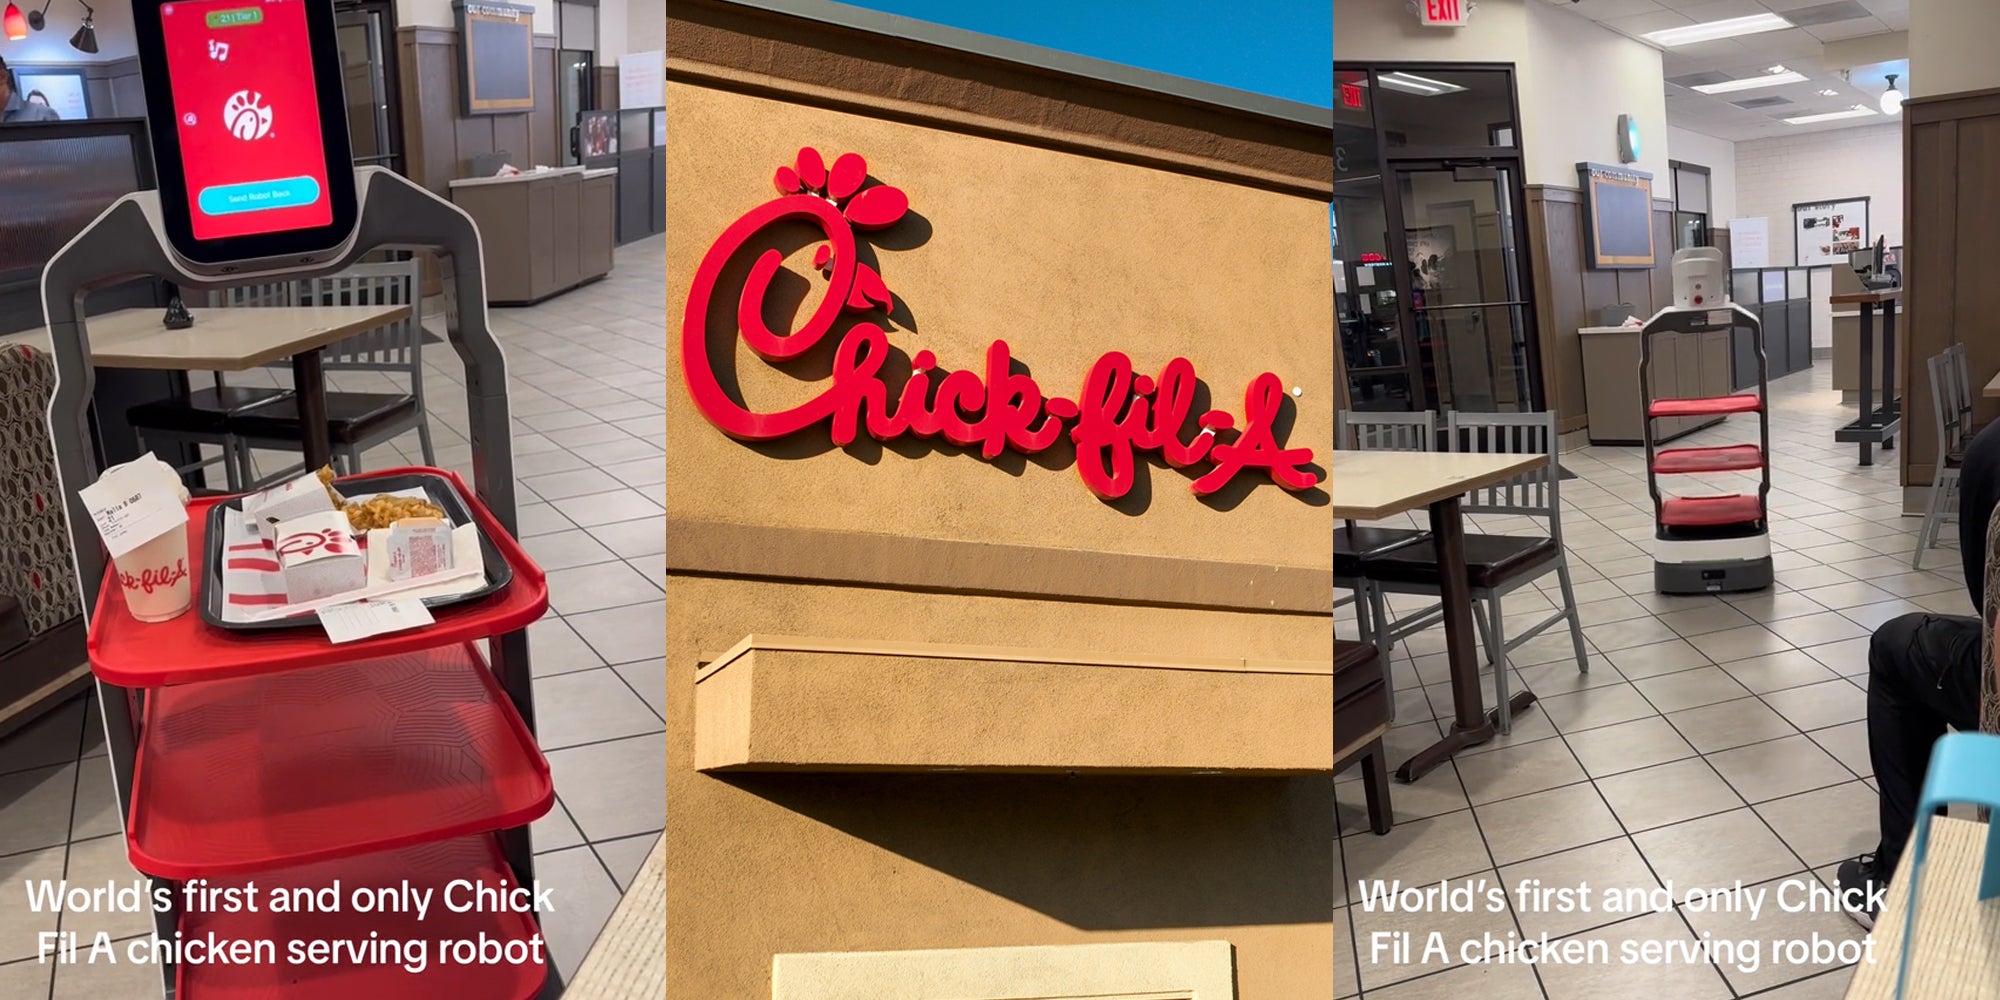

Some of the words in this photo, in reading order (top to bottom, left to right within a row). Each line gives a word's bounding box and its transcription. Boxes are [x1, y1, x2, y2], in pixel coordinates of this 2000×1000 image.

[482, 6, 520, 22] community
[1426, 0, 1460, 22] EXIT
[1604, 170, 1640, 186] community
[682, 148, 1319, 499] Chick-fil-A
